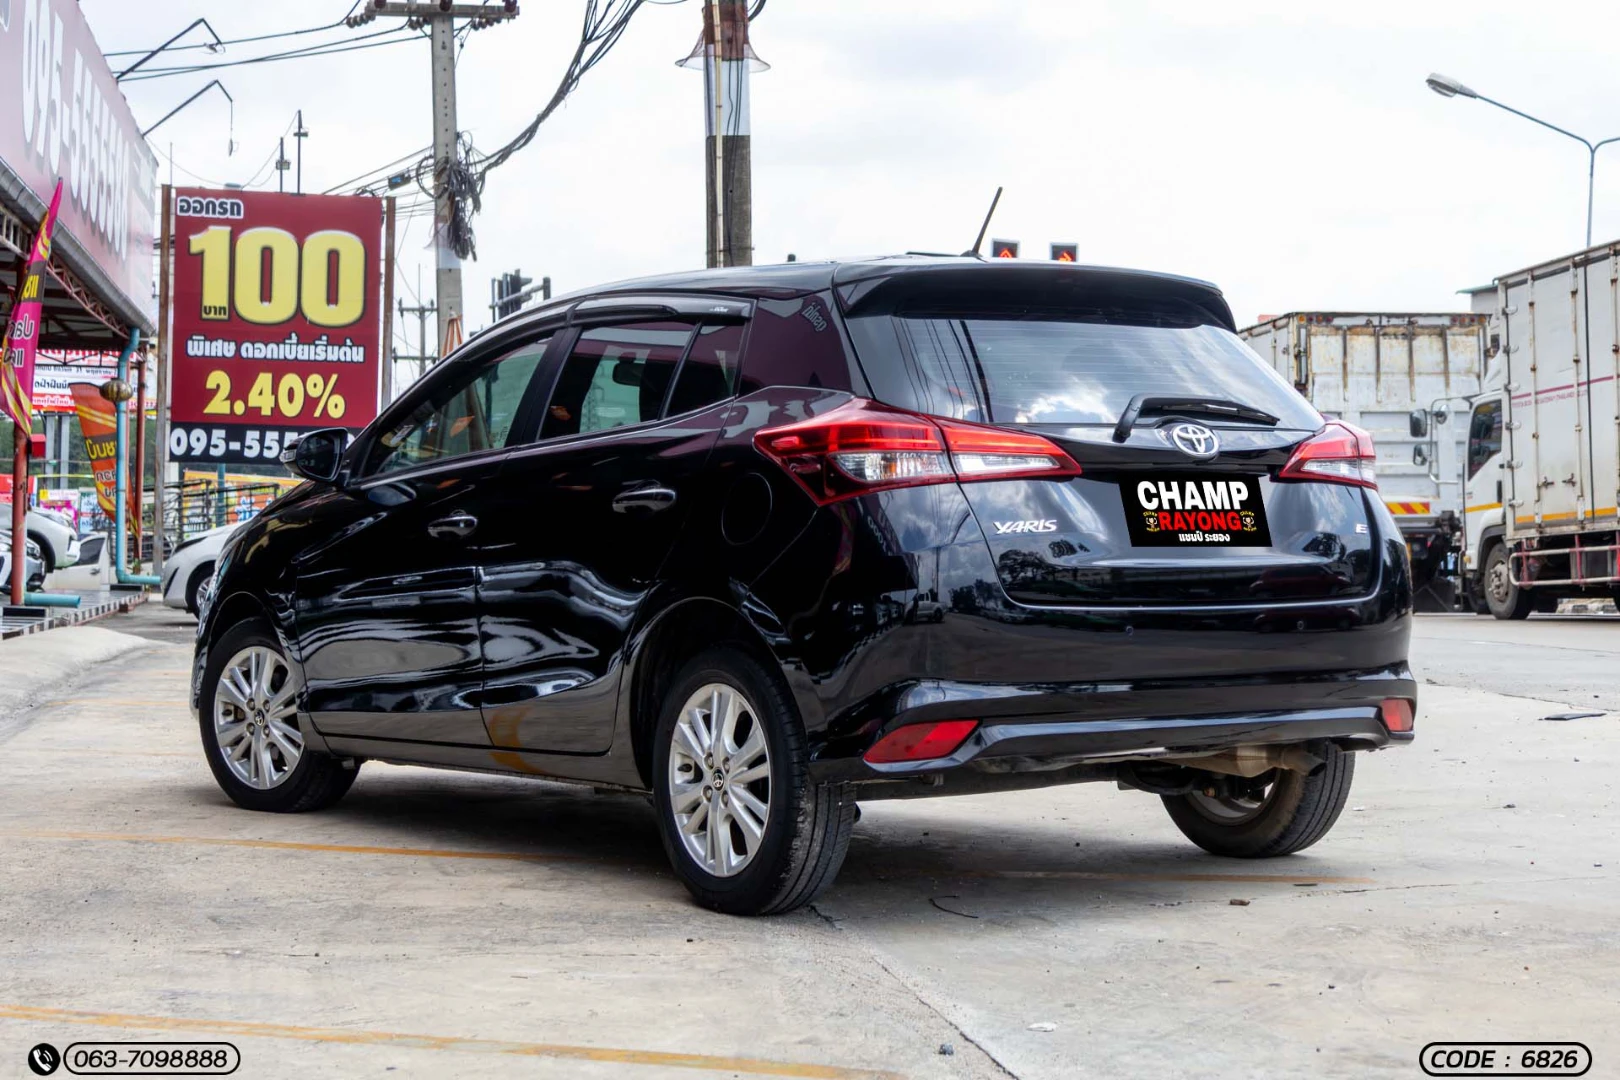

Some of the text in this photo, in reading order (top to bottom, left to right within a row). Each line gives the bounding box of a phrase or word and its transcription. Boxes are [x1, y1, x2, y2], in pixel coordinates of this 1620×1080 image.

[178, 198, 242, 217] ออกรถ
[188, 226, 367, 327] 100
[203, 305, 228, 317] บาท
[187, 332, 365, 363] พิเศษ ดอกเบี้ยเริ่มต้น
[203, 370, 346, 419] 2.40%
[993, 519, 1058, 535] YARIS
[1355, 523, 1369, 534] E
